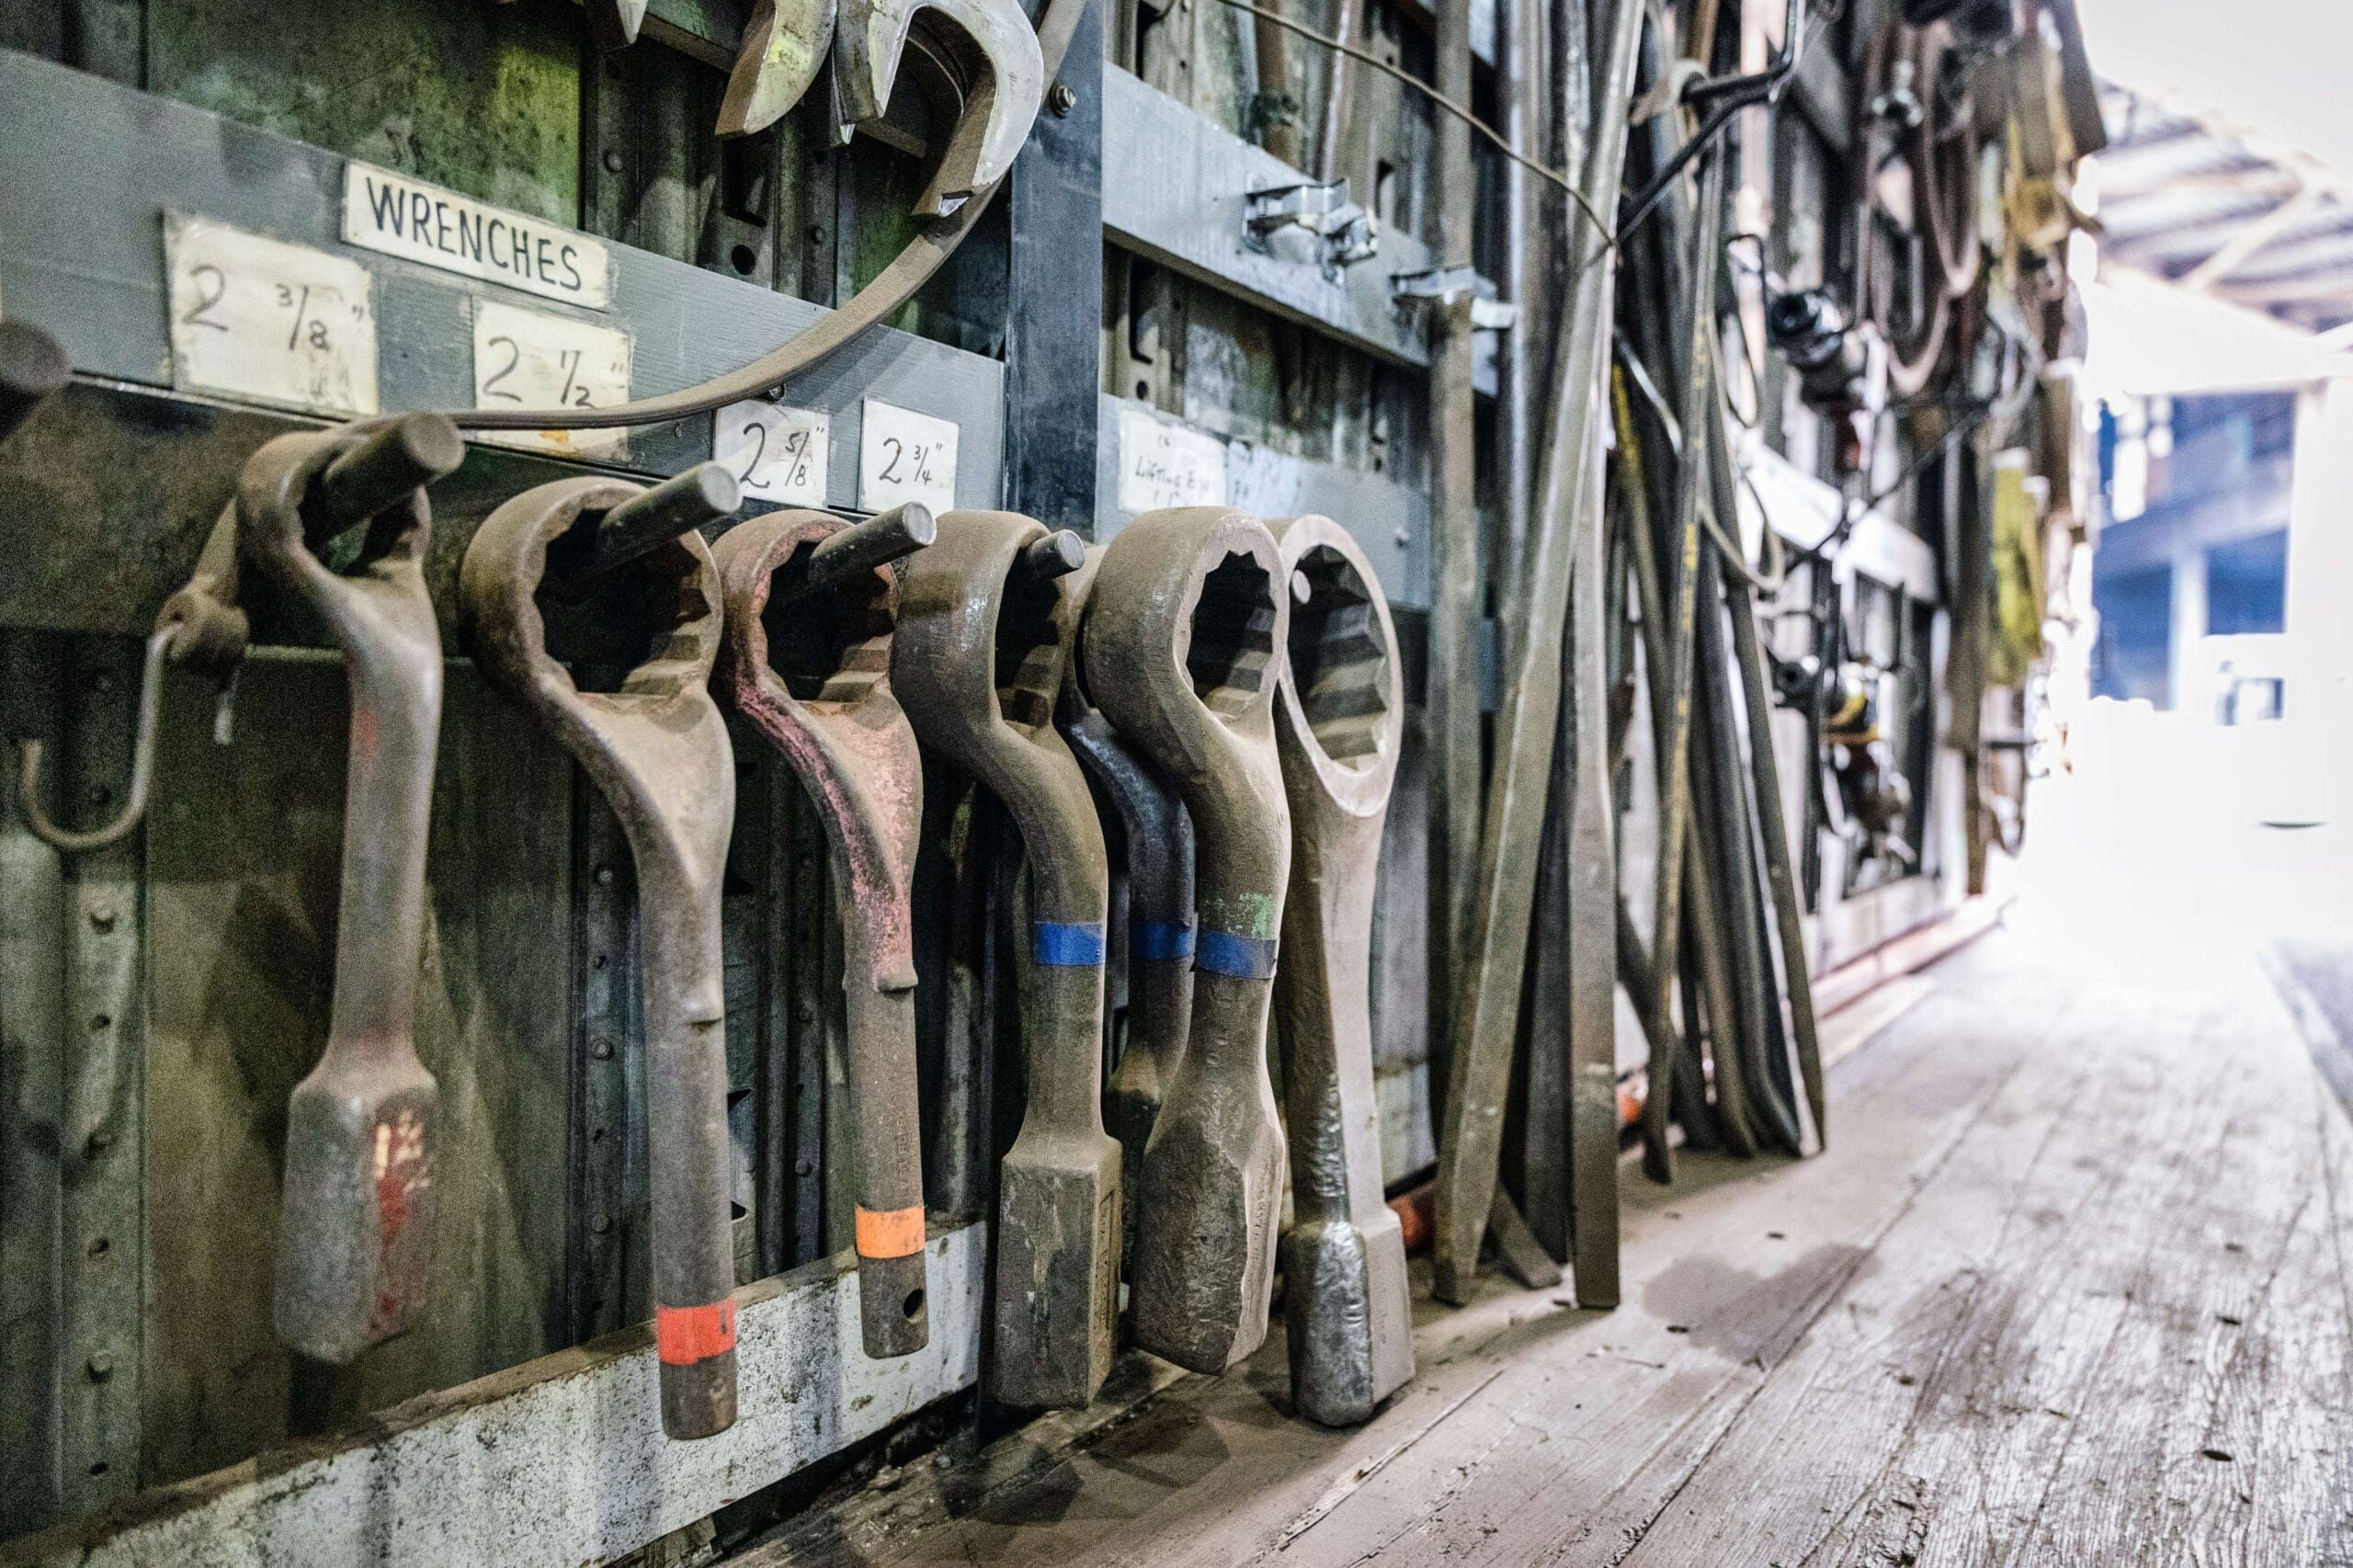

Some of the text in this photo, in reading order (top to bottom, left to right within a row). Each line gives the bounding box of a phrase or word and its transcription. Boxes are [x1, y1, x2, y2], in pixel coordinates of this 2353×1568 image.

[365, 176, 583, 291] WRENCHES
[181, 264, 230, 333] 2
[482, 335, 523, 403] 2
[738, 421, 771, 489] 2
[878, 437, 904, 484] 2
